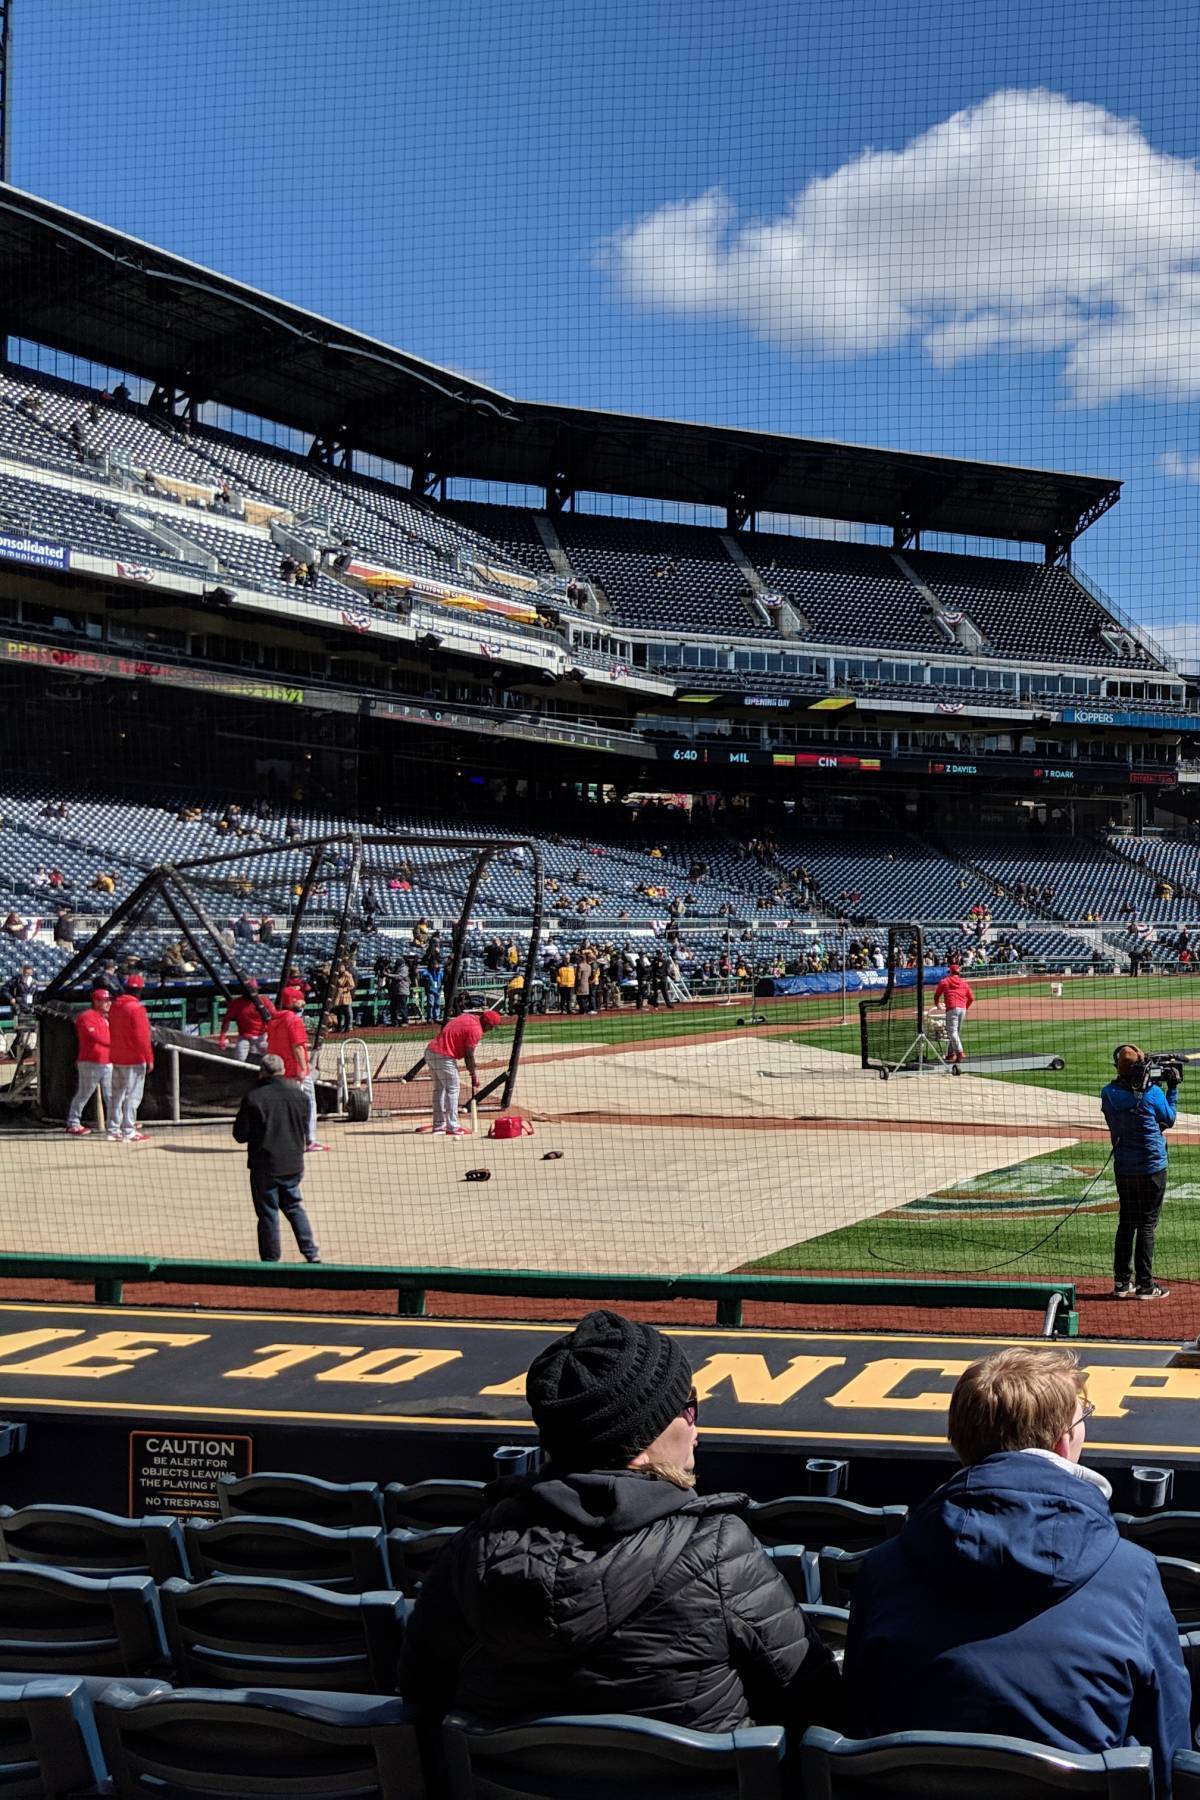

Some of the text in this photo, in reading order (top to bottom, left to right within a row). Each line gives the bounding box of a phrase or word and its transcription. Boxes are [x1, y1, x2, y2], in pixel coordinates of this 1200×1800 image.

[1074, 709, 1115, 724] KOPPERS
[673, 749, 698, 761] 6:40
[729, 752, 750, 764] MIL
[818, 756, 838, 768] CIN
[946, 764, 952, 773] Z
[952, 764, 977, 774] DAVIES
[1044, 769, 1050, 778] T
[1050, 769, 1074, 779] ROARK
[222, 1343, 464, 1384] TO
[146, 1438, 235, 1457] CAUTION
[153, 1456, 228, 1469] BE ALERT FOR
[141, 1467, 190, 1478] OBJECTS
[139, 1478, 161, 1488] THE
[163, 1479, 208, 1490] PLAYING
[145, 1497, 223, 1510] NO TRESPASSI
